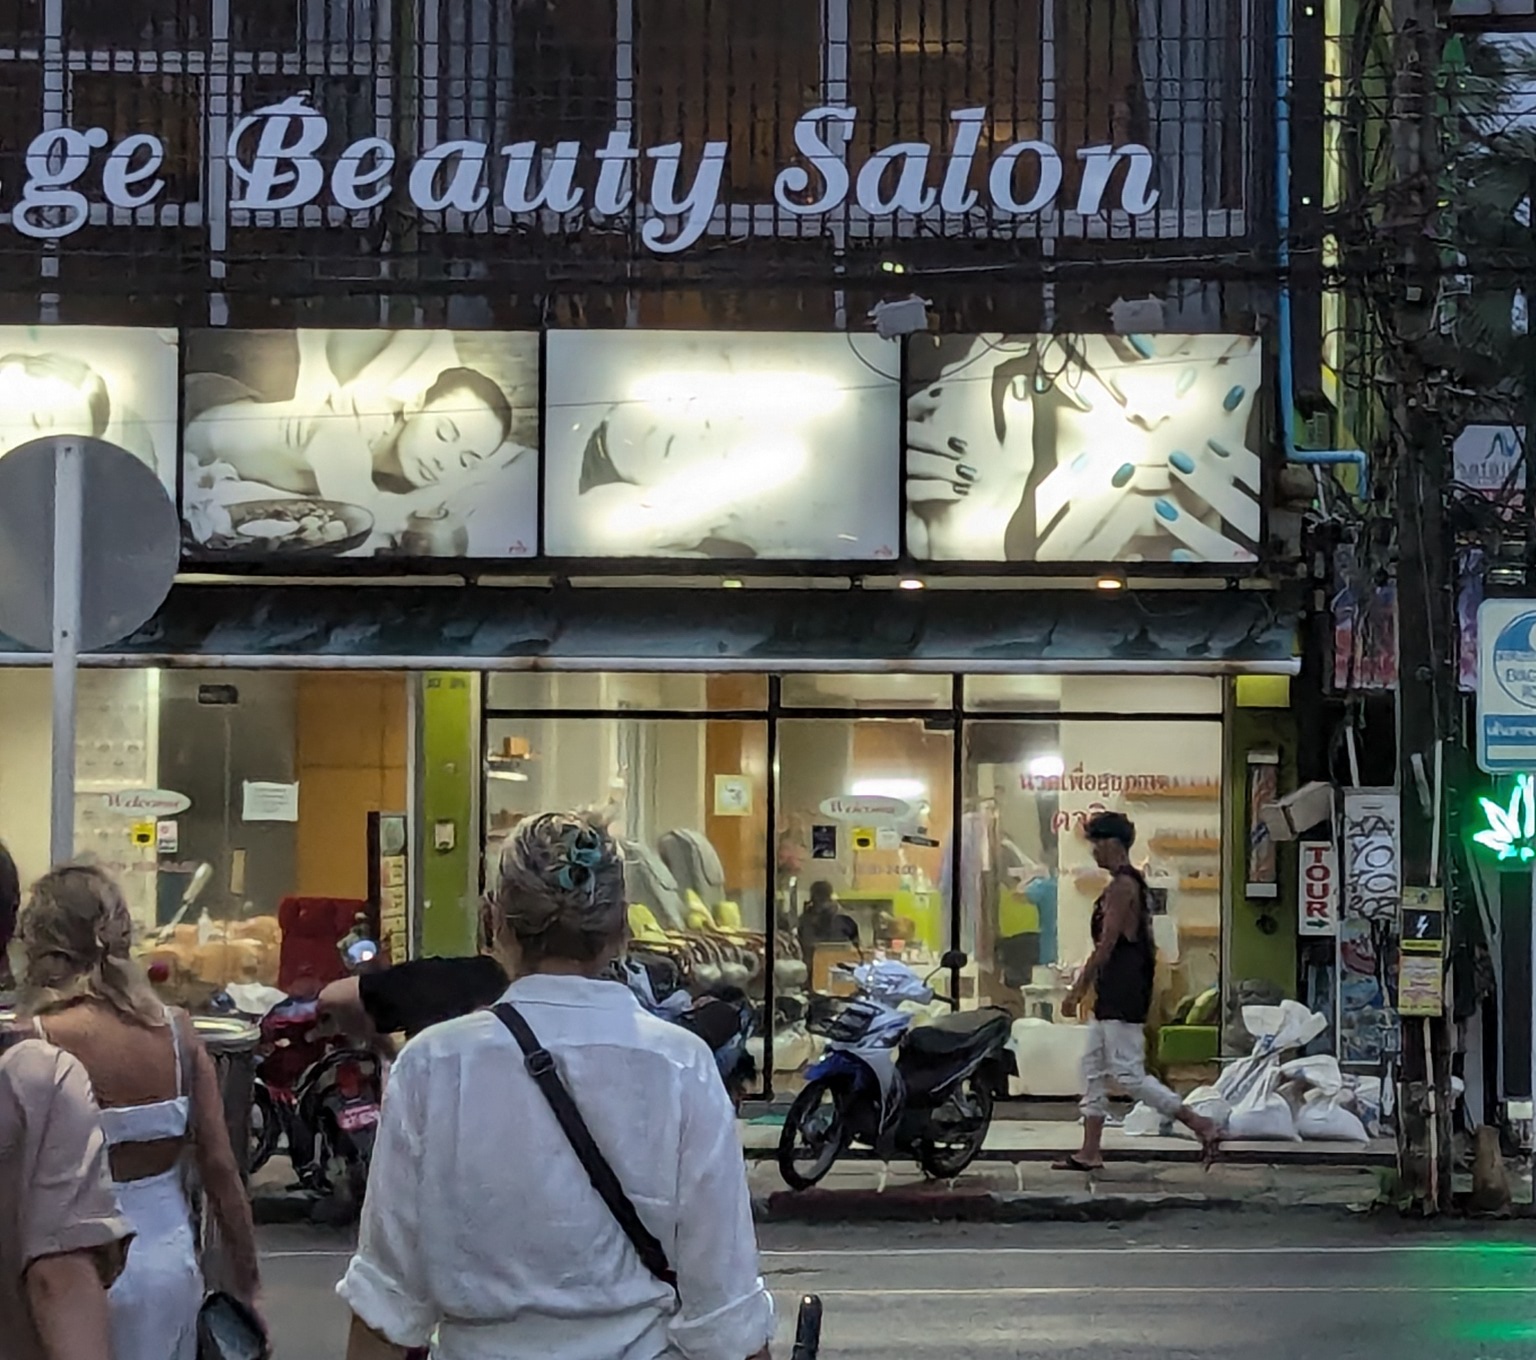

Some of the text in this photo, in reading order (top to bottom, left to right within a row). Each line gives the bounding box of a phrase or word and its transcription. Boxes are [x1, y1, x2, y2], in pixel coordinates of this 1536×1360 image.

[230, 92, 729, 254] Beauty
[774, 105, 1161, 217] Salon
[1306, 846, 1332, 919] TOUR
